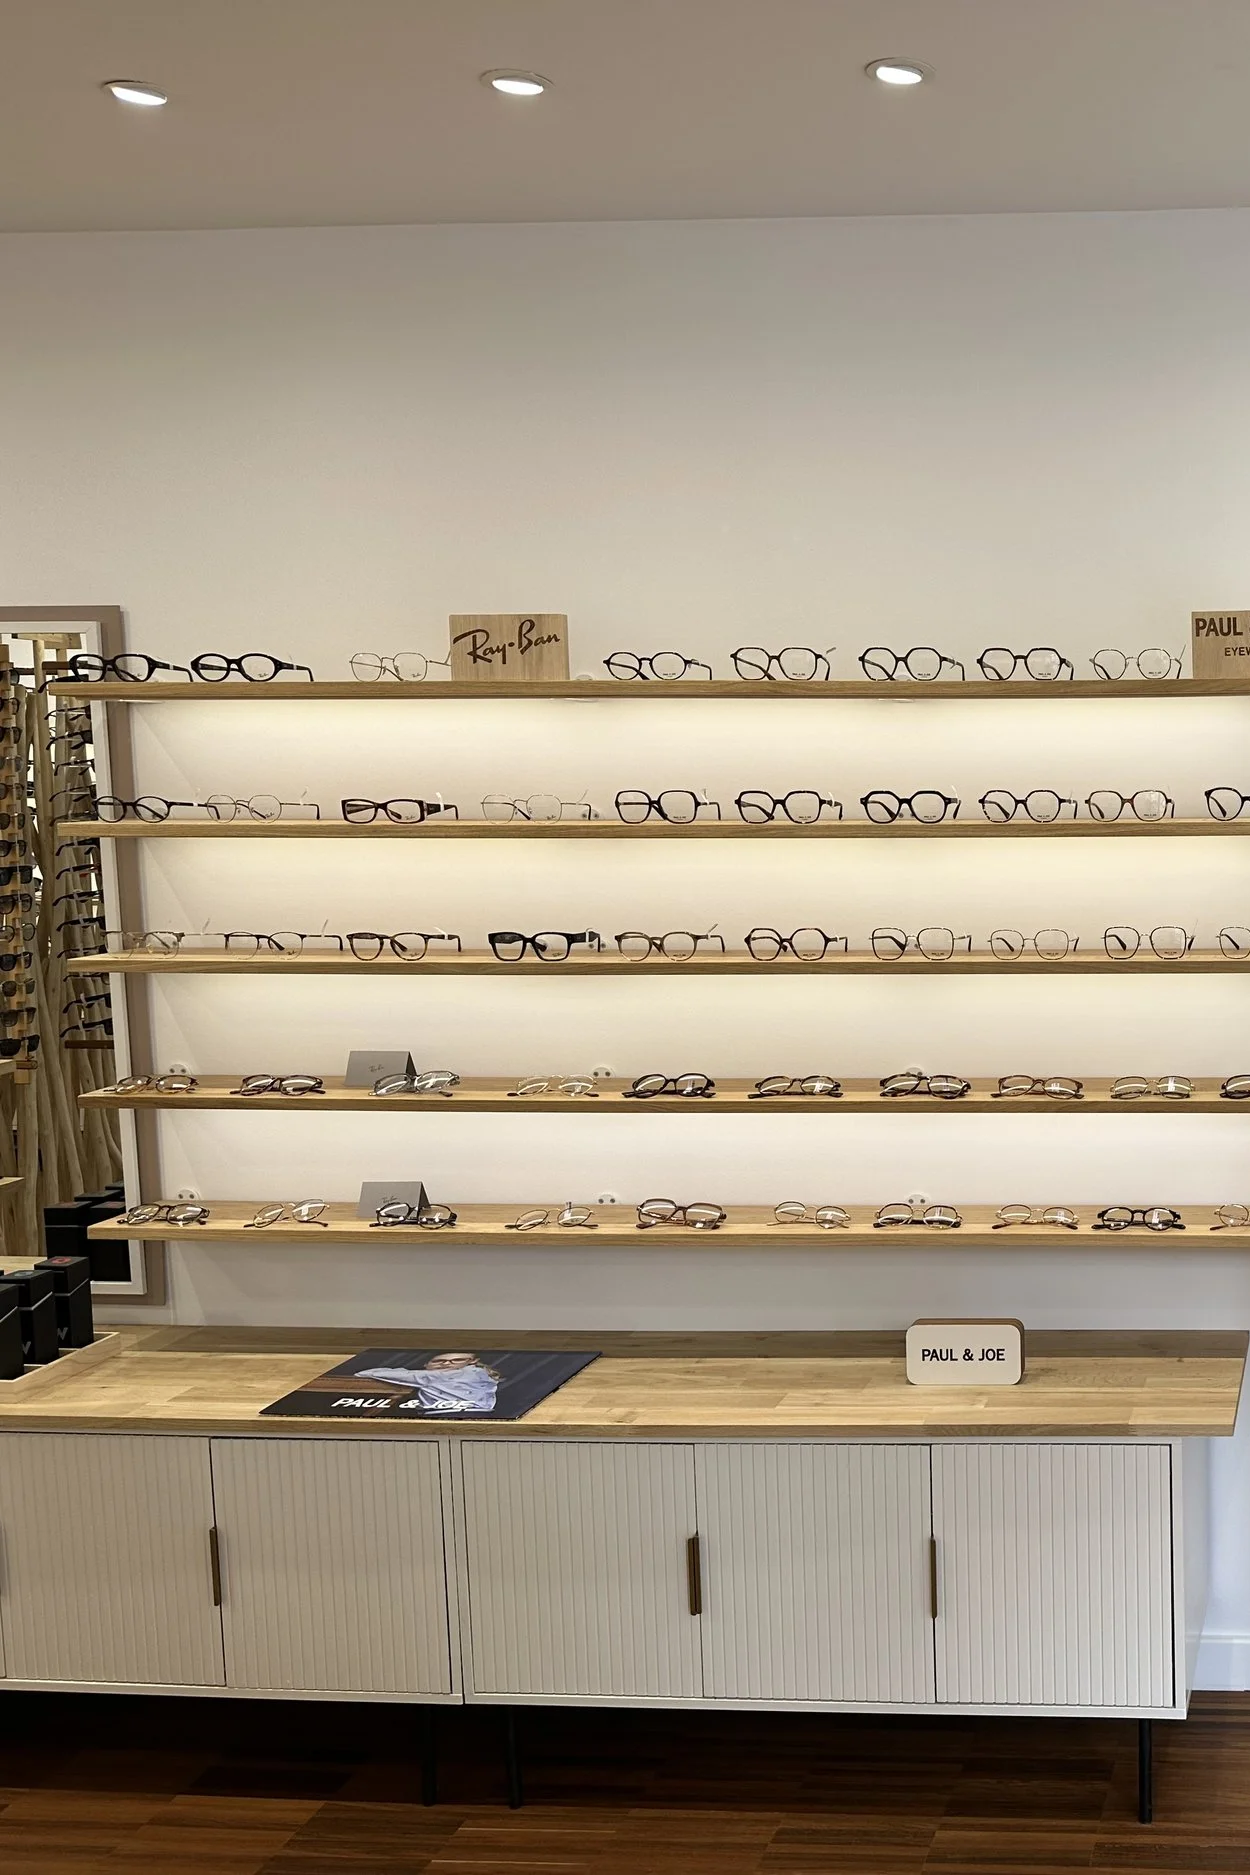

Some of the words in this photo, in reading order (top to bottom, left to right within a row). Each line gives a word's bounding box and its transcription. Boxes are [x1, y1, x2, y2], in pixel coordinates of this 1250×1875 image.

[1195, 617, 1243, 637] PAUL
[922, 1348, 958, 1361] PAUL
[962, 1348, 974, 1361] &
[978, 1348, 1005, 1361] JOE
[331, 1398, 391, 1408] PAUL
[400, 1399, 420, 1409] &
[423, 1400, 476, 1411] JOE
